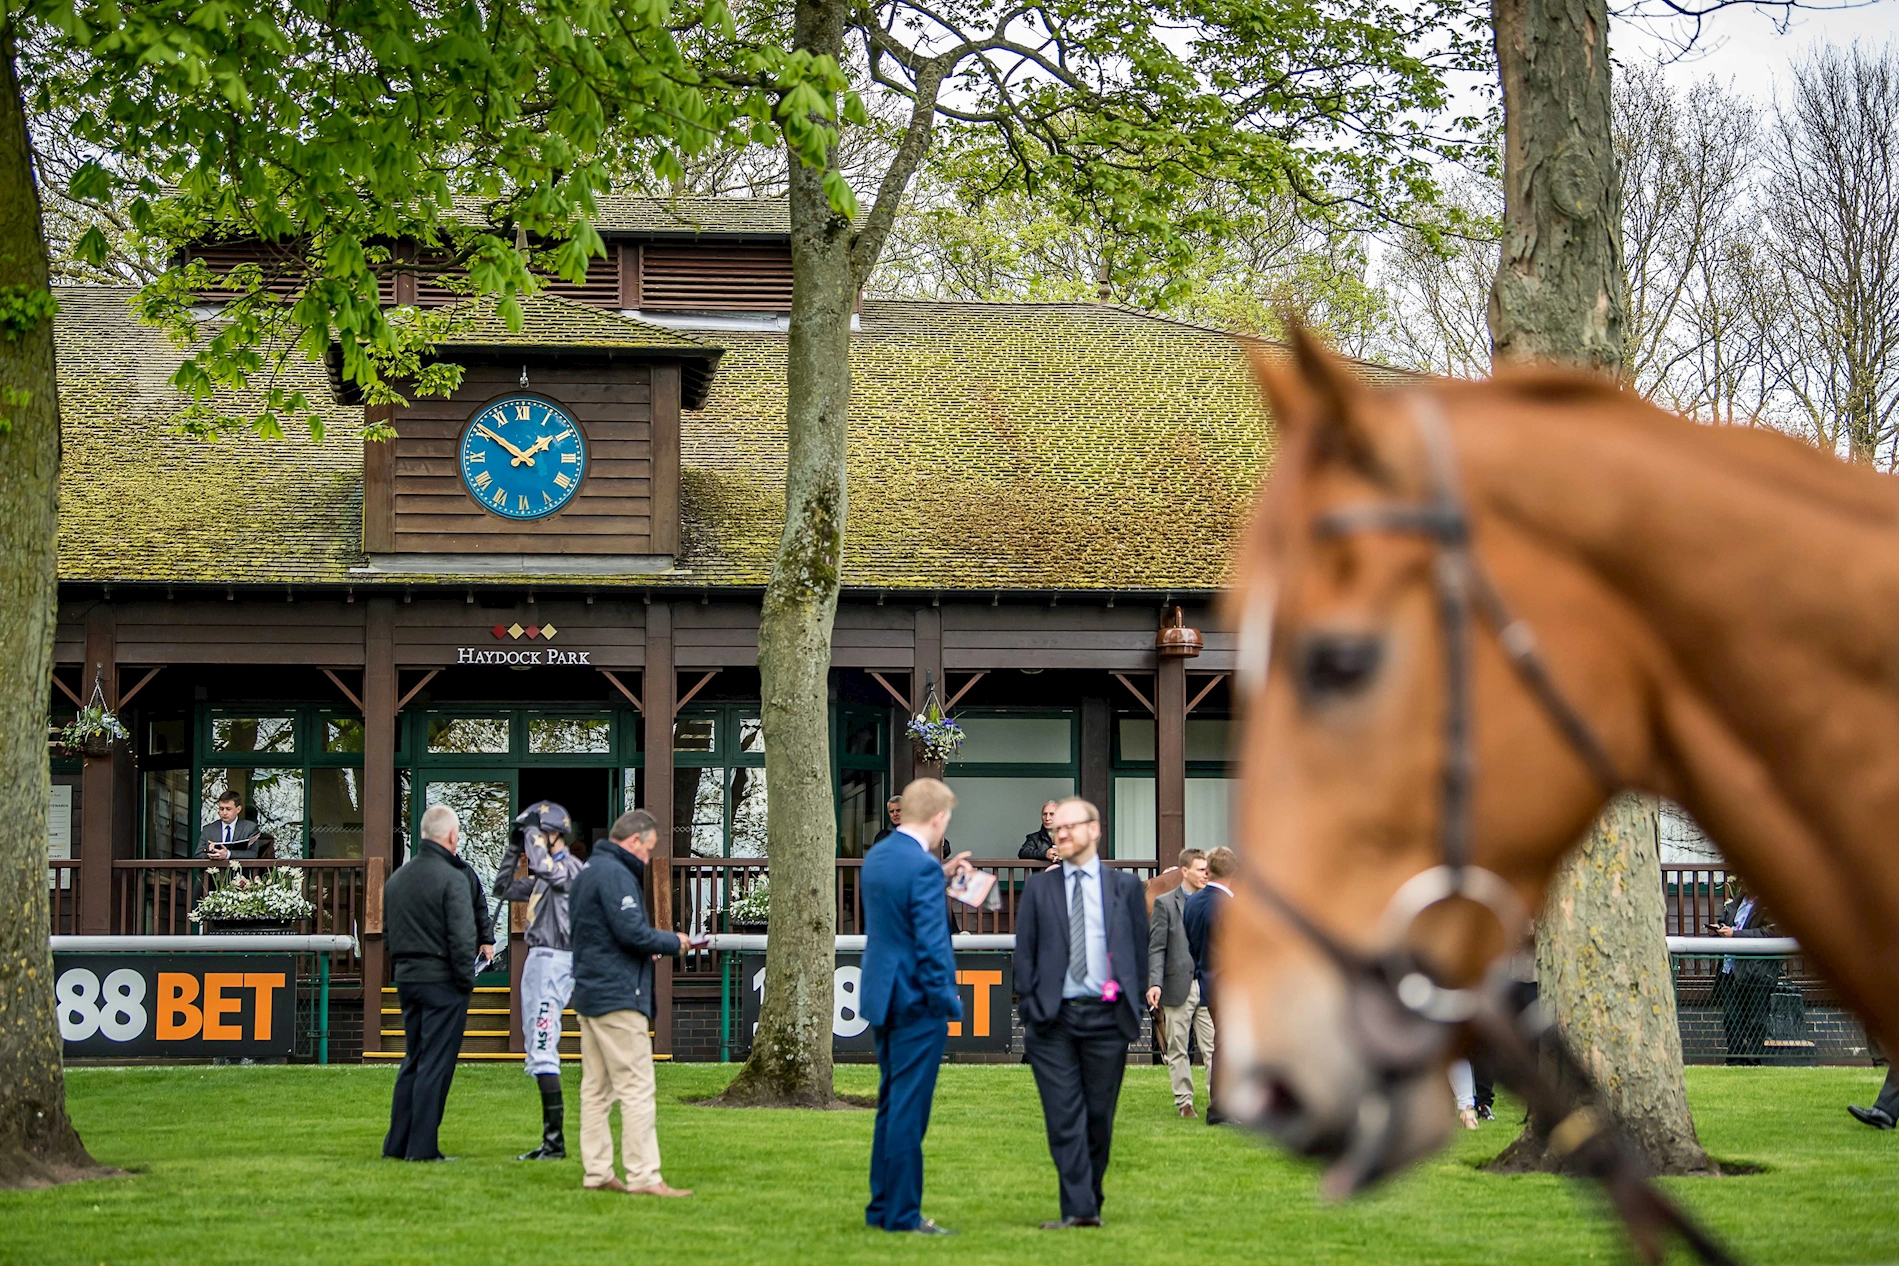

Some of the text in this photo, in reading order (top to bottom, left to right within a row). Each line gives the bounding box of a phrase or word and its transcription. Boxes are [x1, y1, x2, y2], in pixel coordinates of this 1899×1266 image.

[492, 410, 509, 428] XI
[515, 406, 530, 420] XII
[555, 429, 571, 442] II
[561, 452, 576, 464] III
[518, 495, 530, 510] VI
[457, 648, 590, 665] HAYDOCK PARK
